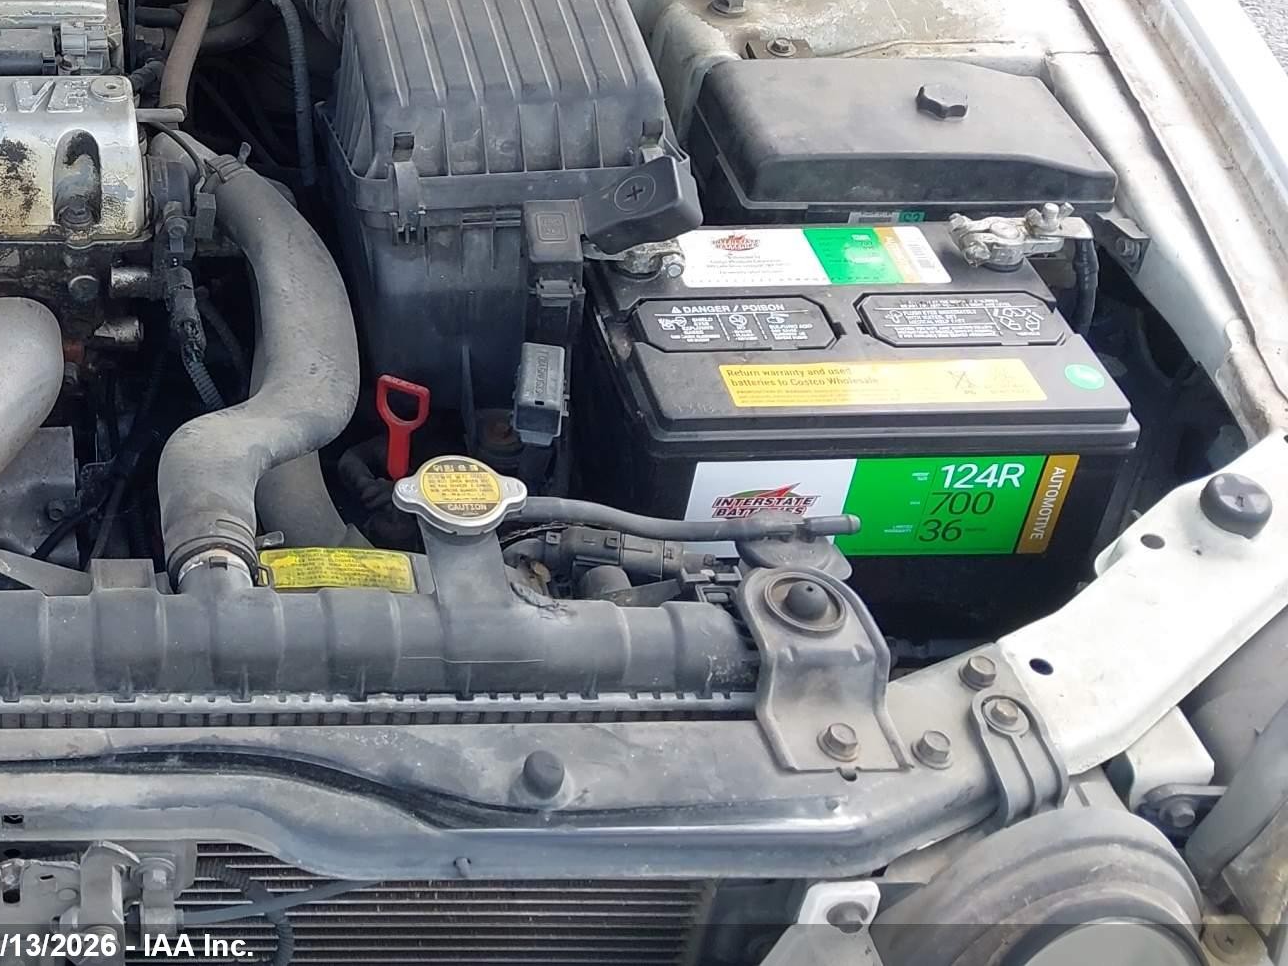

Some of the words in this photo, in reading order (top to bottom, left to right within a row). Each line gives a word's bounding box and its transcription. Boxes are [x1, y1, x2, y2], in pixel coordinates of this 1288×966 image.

[683, 305, 730, 314] DANGER
[743, 304, 785, 312] POISON
[727, 367, 761, 378] Return
[762, 368, 804, 378] warranty
[807, 367, 826, 376] and
[829, 367, 852, 376] used
[730, 377, 777, 387] batteries
[778, 377, 789, 386] to
[791, 376, 827, 386] Costco
[829, 376, 879, 386] Wholesale
[941, 463, 1025, 489] 124R
[448, 503, 487, 511] CAUTION
[716, 497, 814, 506] INTERSTATE
[930, 491, 994, 516] 700
[1030, 466, 1067, 540] AUTOMOTIVE
[918, 518, 962, 543] 36
